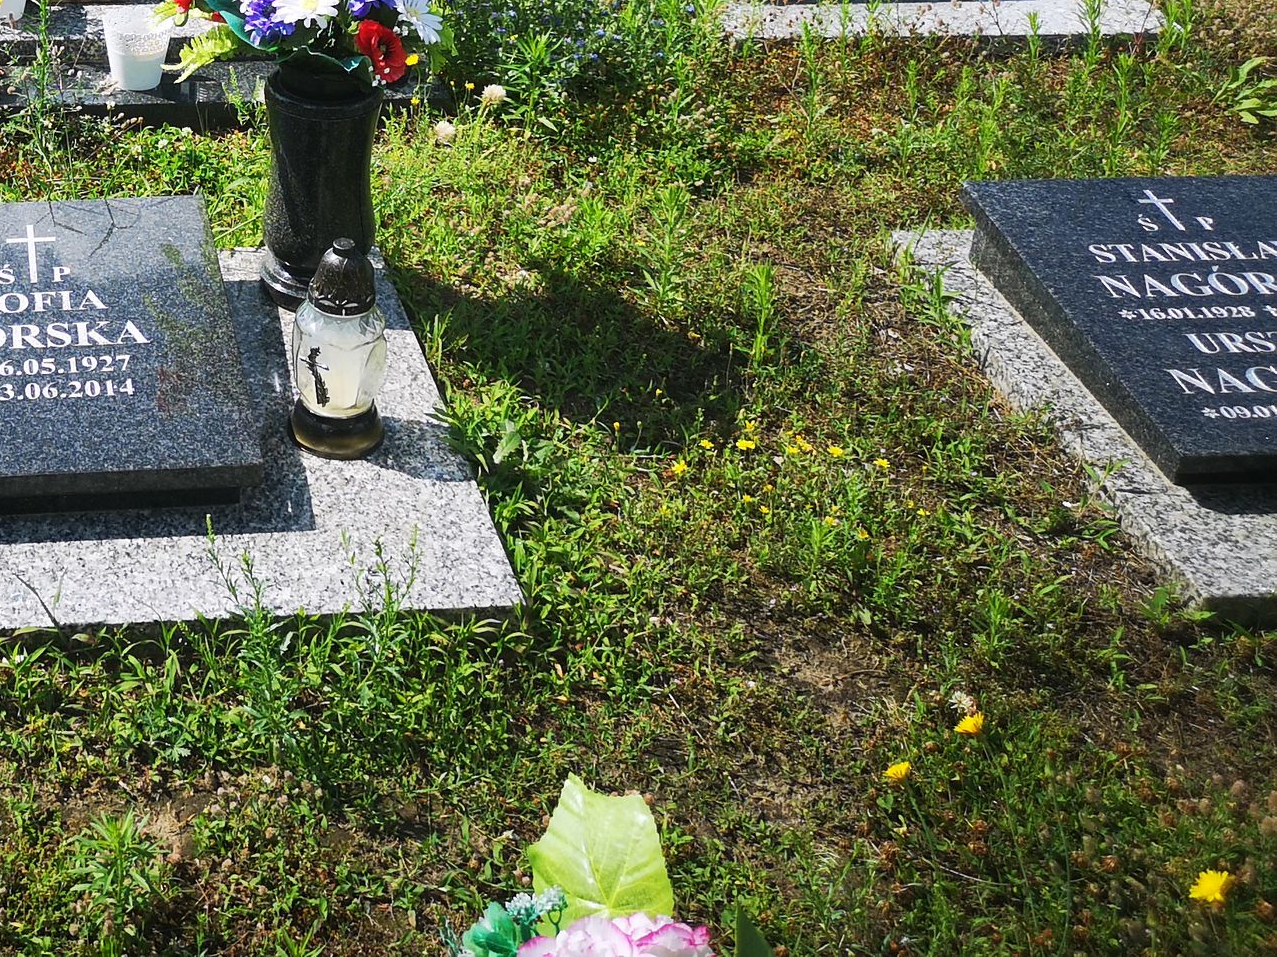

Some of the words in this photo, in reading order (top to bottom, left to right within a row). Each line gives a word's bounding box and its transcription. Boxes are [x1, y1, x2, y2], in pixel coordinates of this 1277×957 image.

[1194, 216, 1214, 231] P
[1088, 241, 1277, 263] STANISŁA
[51, 266, 71, 283] P
[1181, 331, 1277, 354] URS
